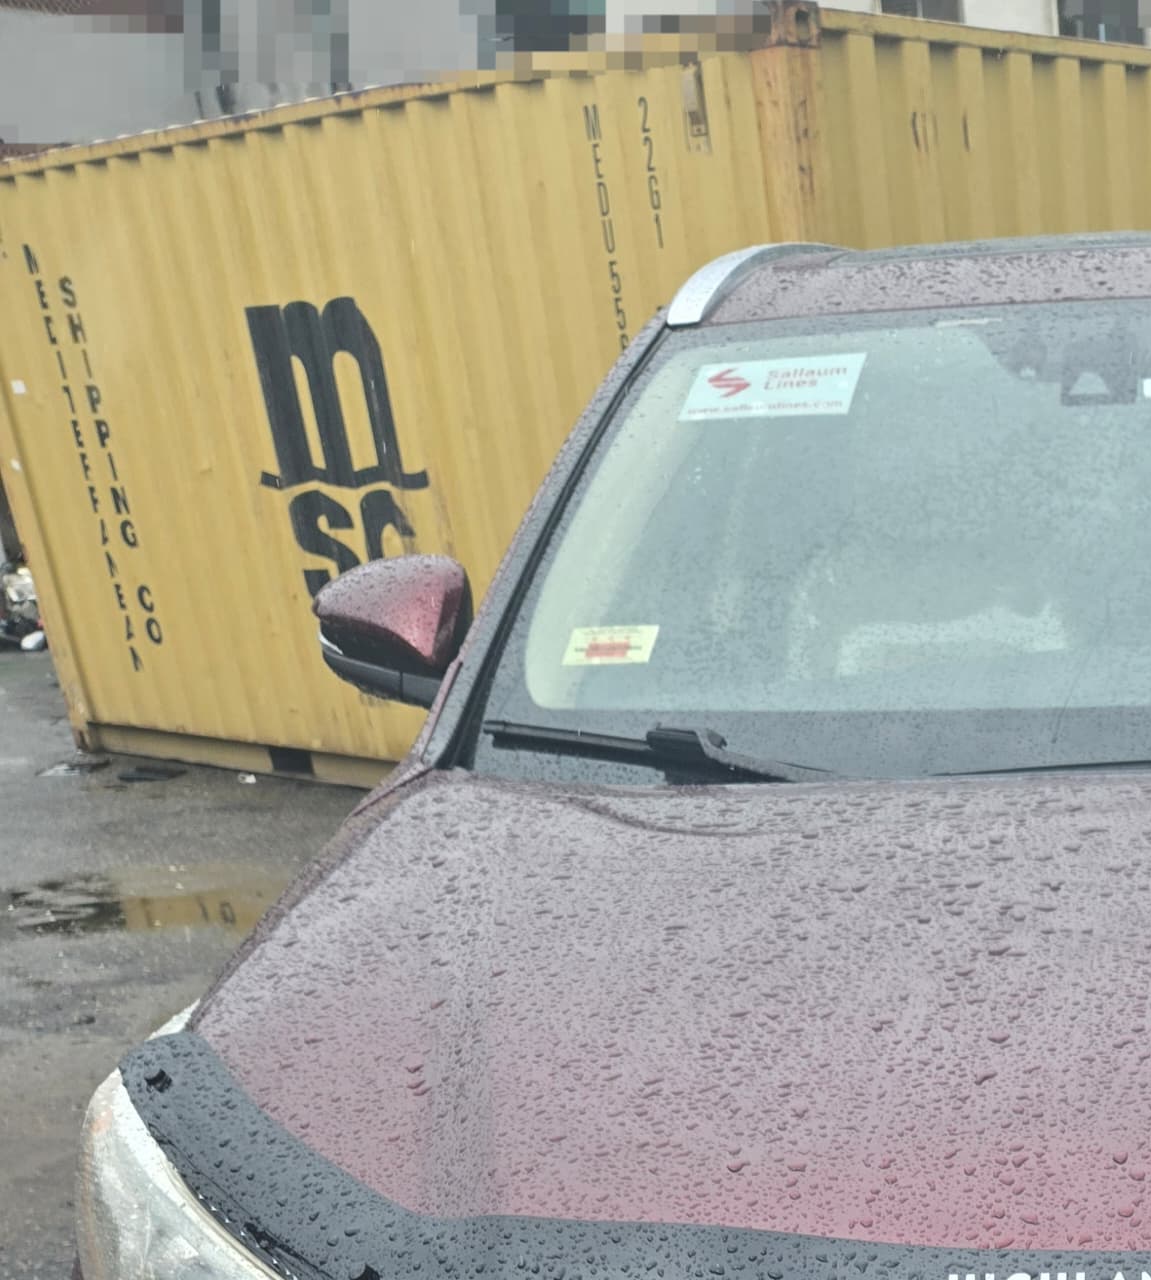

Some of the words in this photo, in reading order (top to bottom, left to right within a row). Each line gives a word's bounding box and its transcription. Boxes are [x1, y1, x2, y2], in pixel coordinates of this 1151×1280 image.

[58, 275, 139, 548] SHIPPING
[137, 584, 163, 645] CO
[763, 379, 819, 391] Lines
